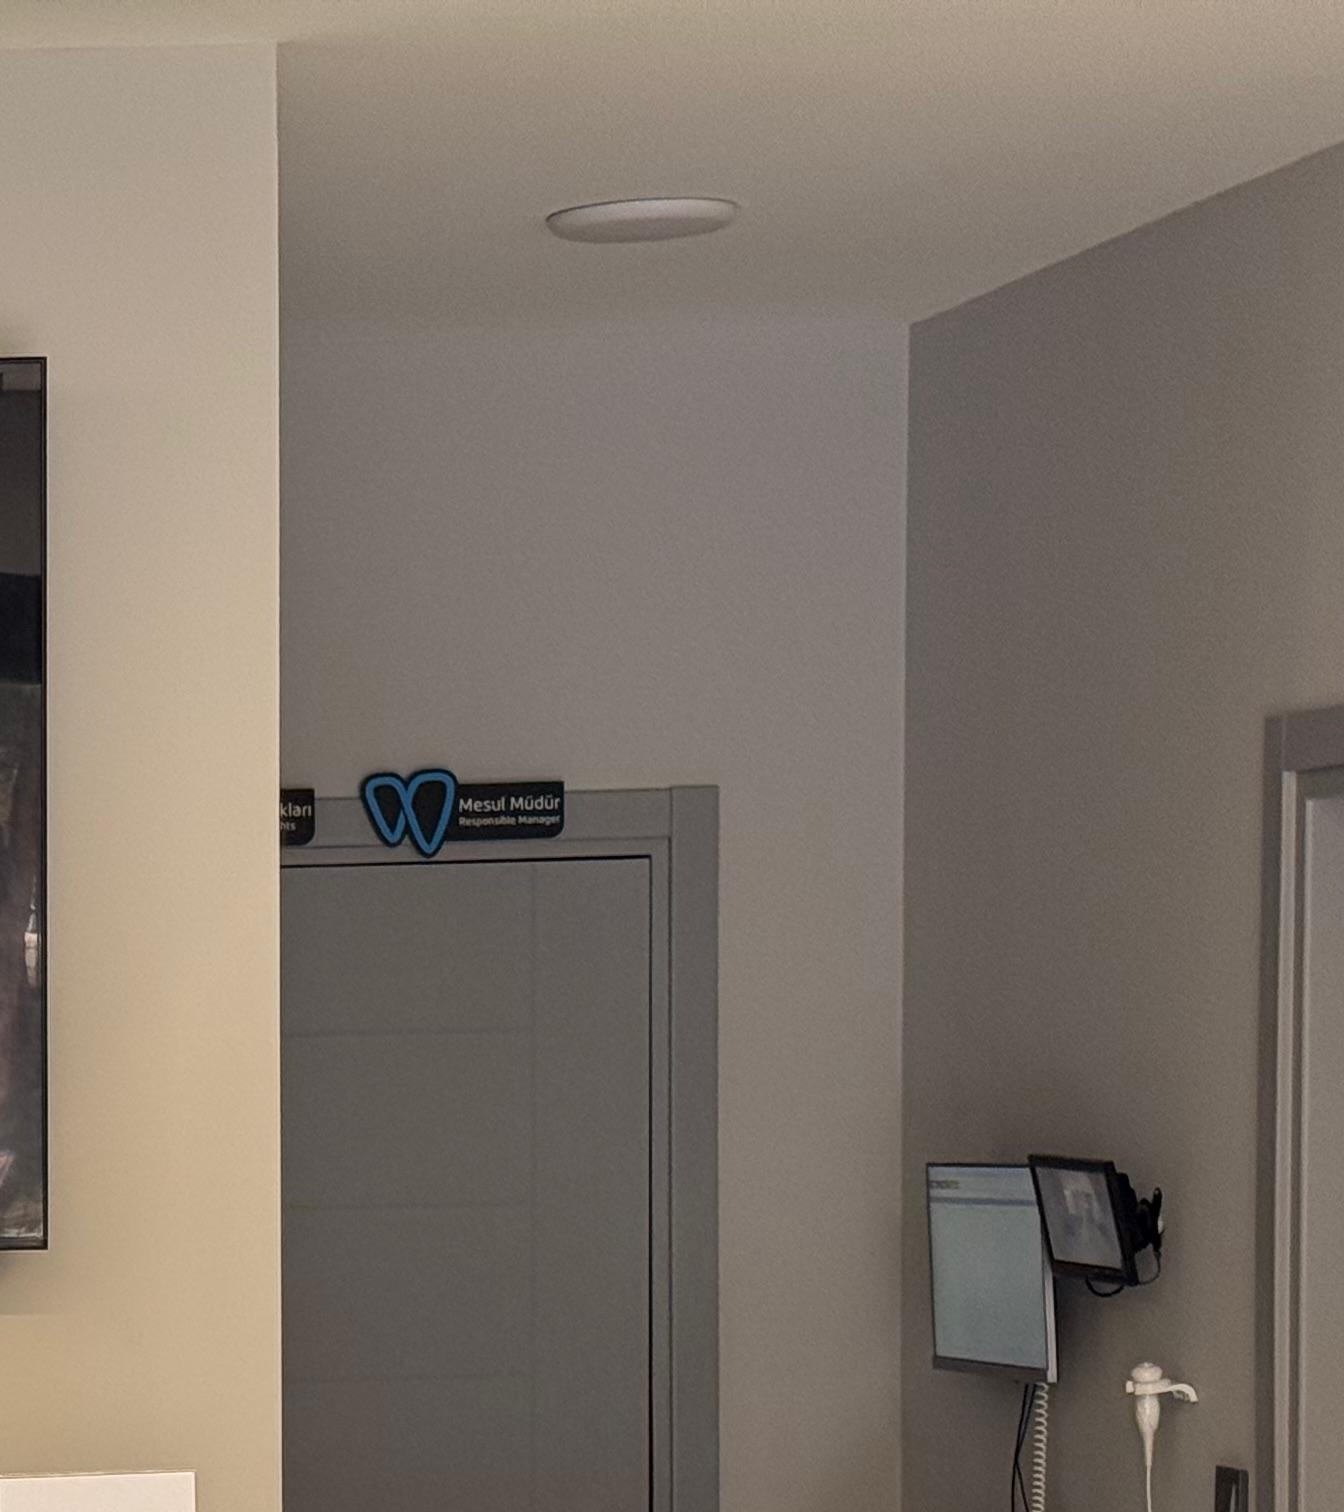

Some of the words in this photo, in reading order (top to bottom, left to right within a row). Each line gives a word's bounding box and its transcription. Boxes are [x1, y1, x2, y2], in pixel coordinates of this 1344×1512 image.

[459, 796, 506, 812] Mesul
[510, 795, 560, 811] Müdür
[458, 816, 517, 828] Responsible
[518, 815, 560, 827] Manager
